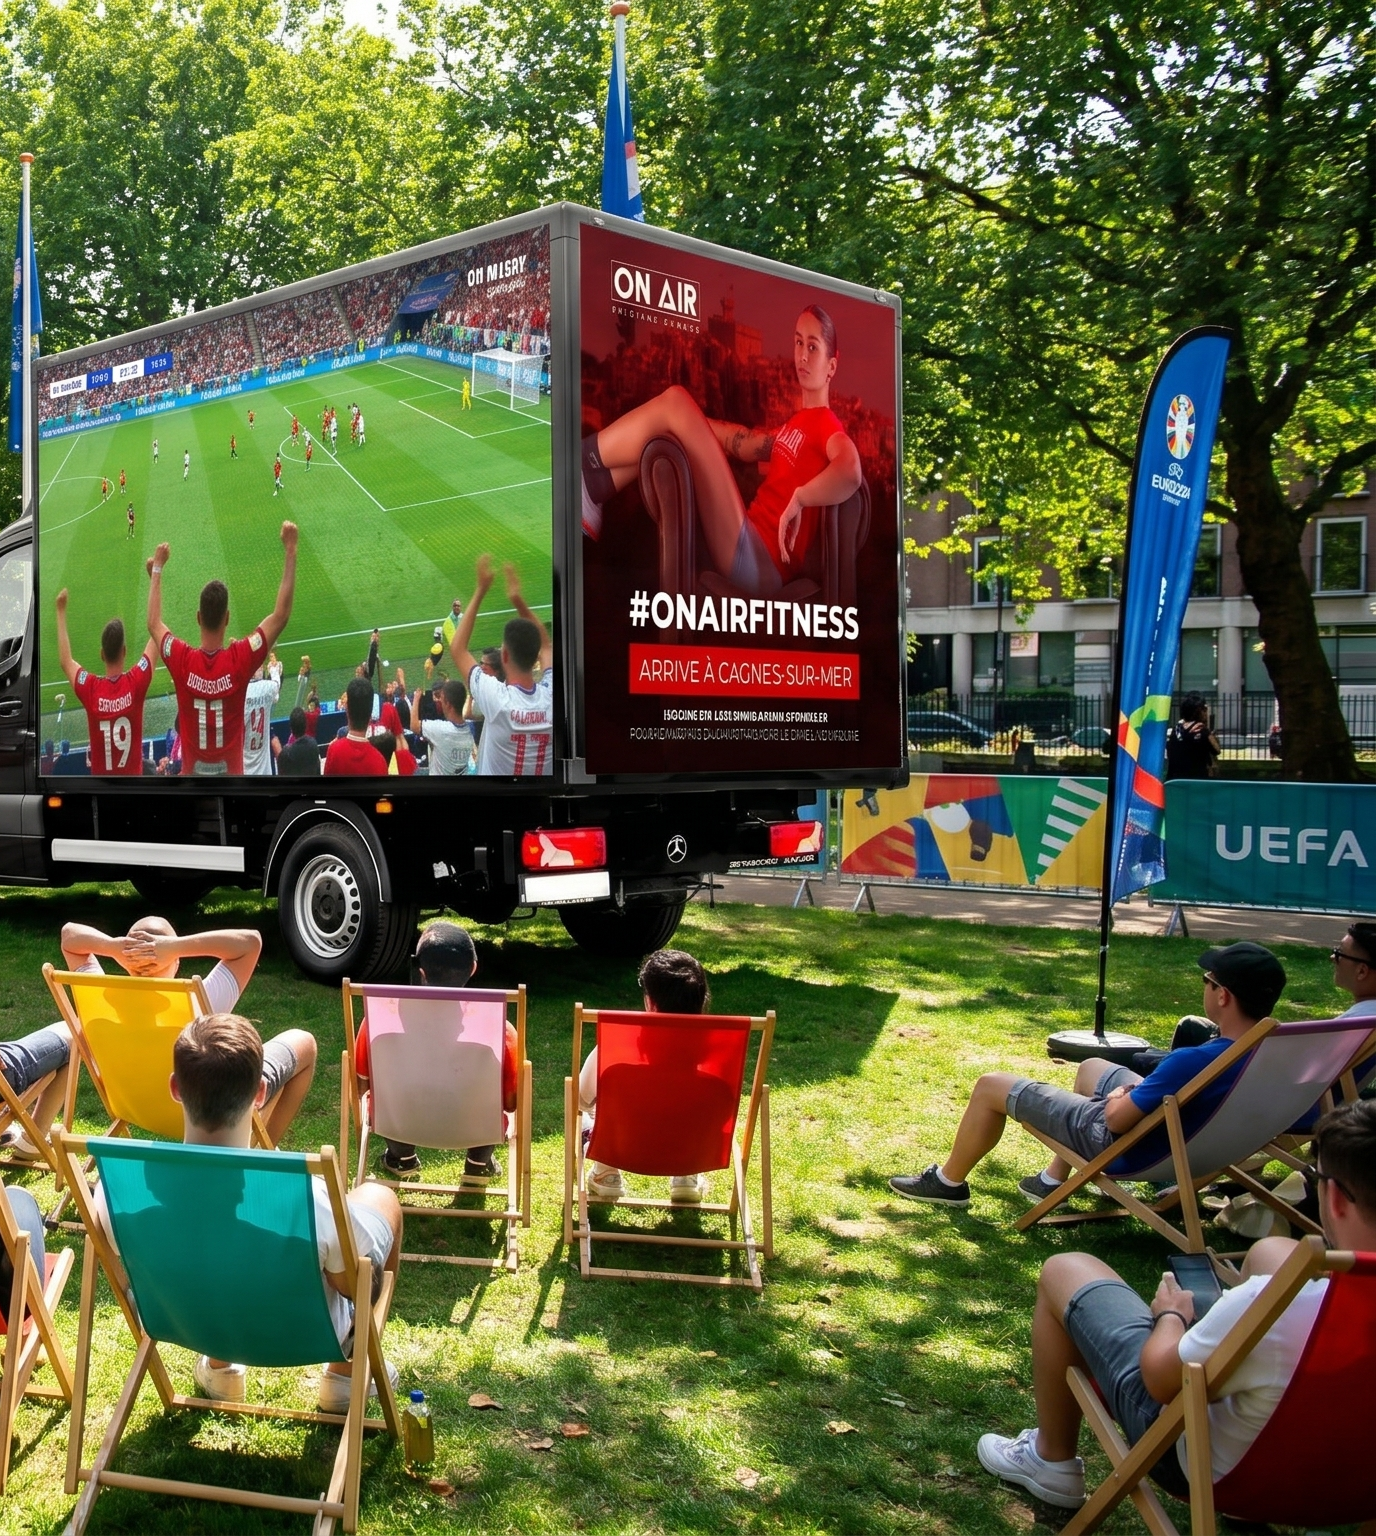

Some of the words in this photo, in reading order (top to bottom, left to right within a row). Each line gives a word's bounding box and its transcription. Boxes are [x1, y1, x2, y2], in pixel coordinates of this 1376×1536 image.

[614, 267, 651, 305] ON
[657, 278, 697, 317] AIR
[629, 589, 860, 640] #ONAIRFITNESS
[638, 659, 700, 683] ARRIVE
[703, 655, 715, 683] À
[718, 661, 852, 688] CAGNES-SUR-MER
[99, 716, 132, 771] 19
[193, 698, 224, 750] 11
[1215, 824, 1369, 868] UEFA
